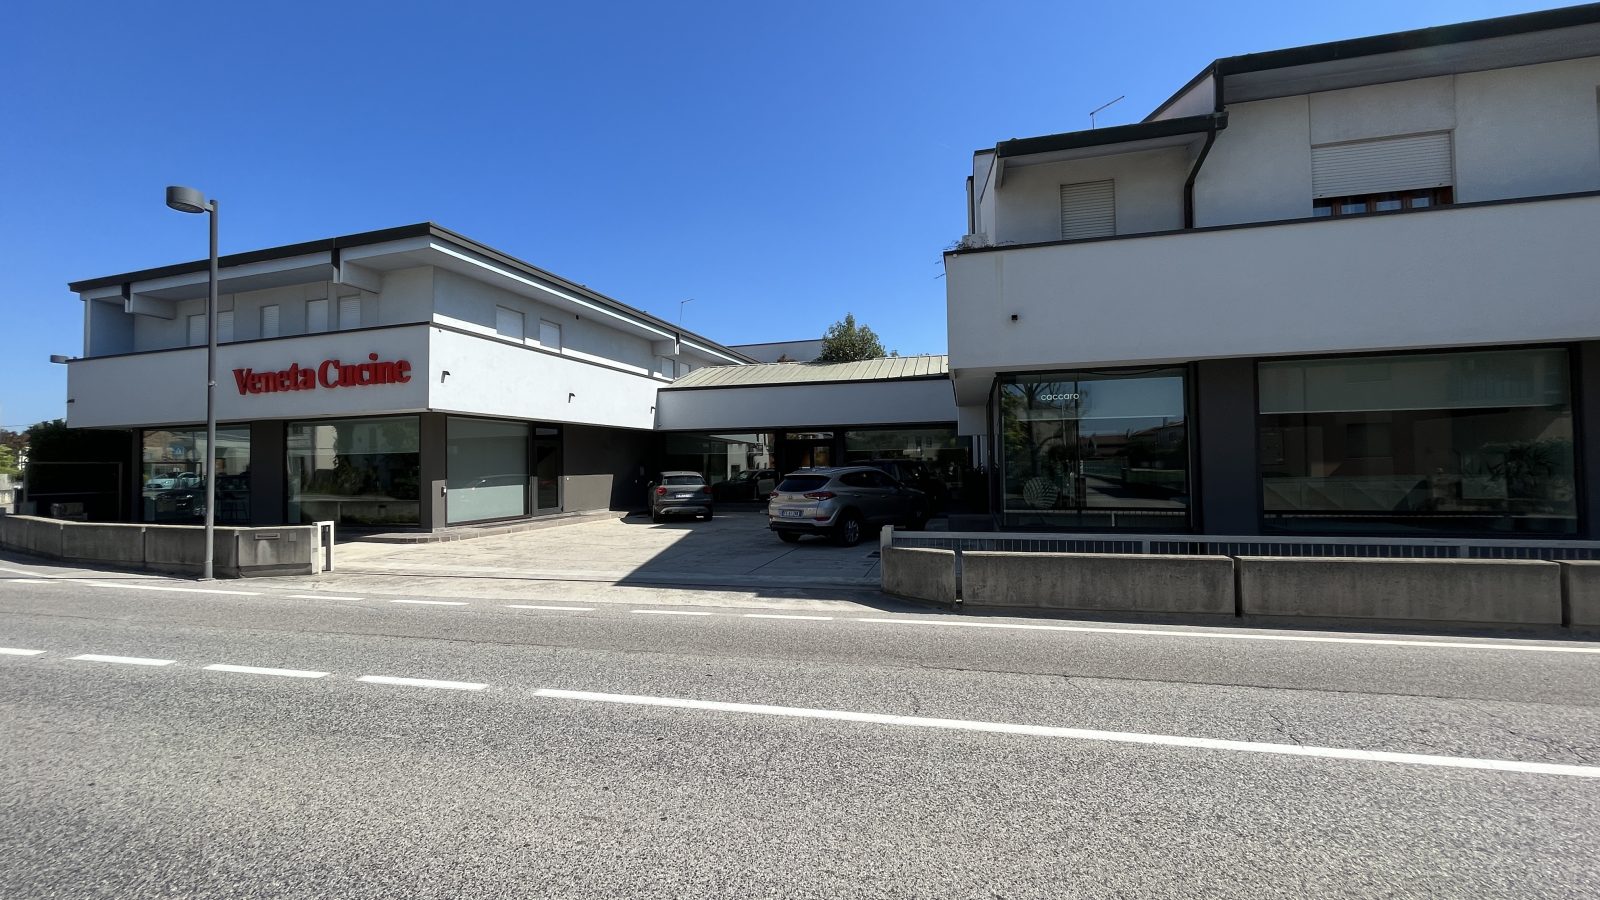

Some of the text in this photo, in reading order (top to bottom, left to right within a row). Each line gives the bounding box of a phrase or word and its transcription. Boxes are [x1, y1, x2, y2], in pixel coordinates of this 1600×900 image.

[232, 352, 411, 395] Veneta Cucine
[1040, 393, 1080, 401] caccaro
